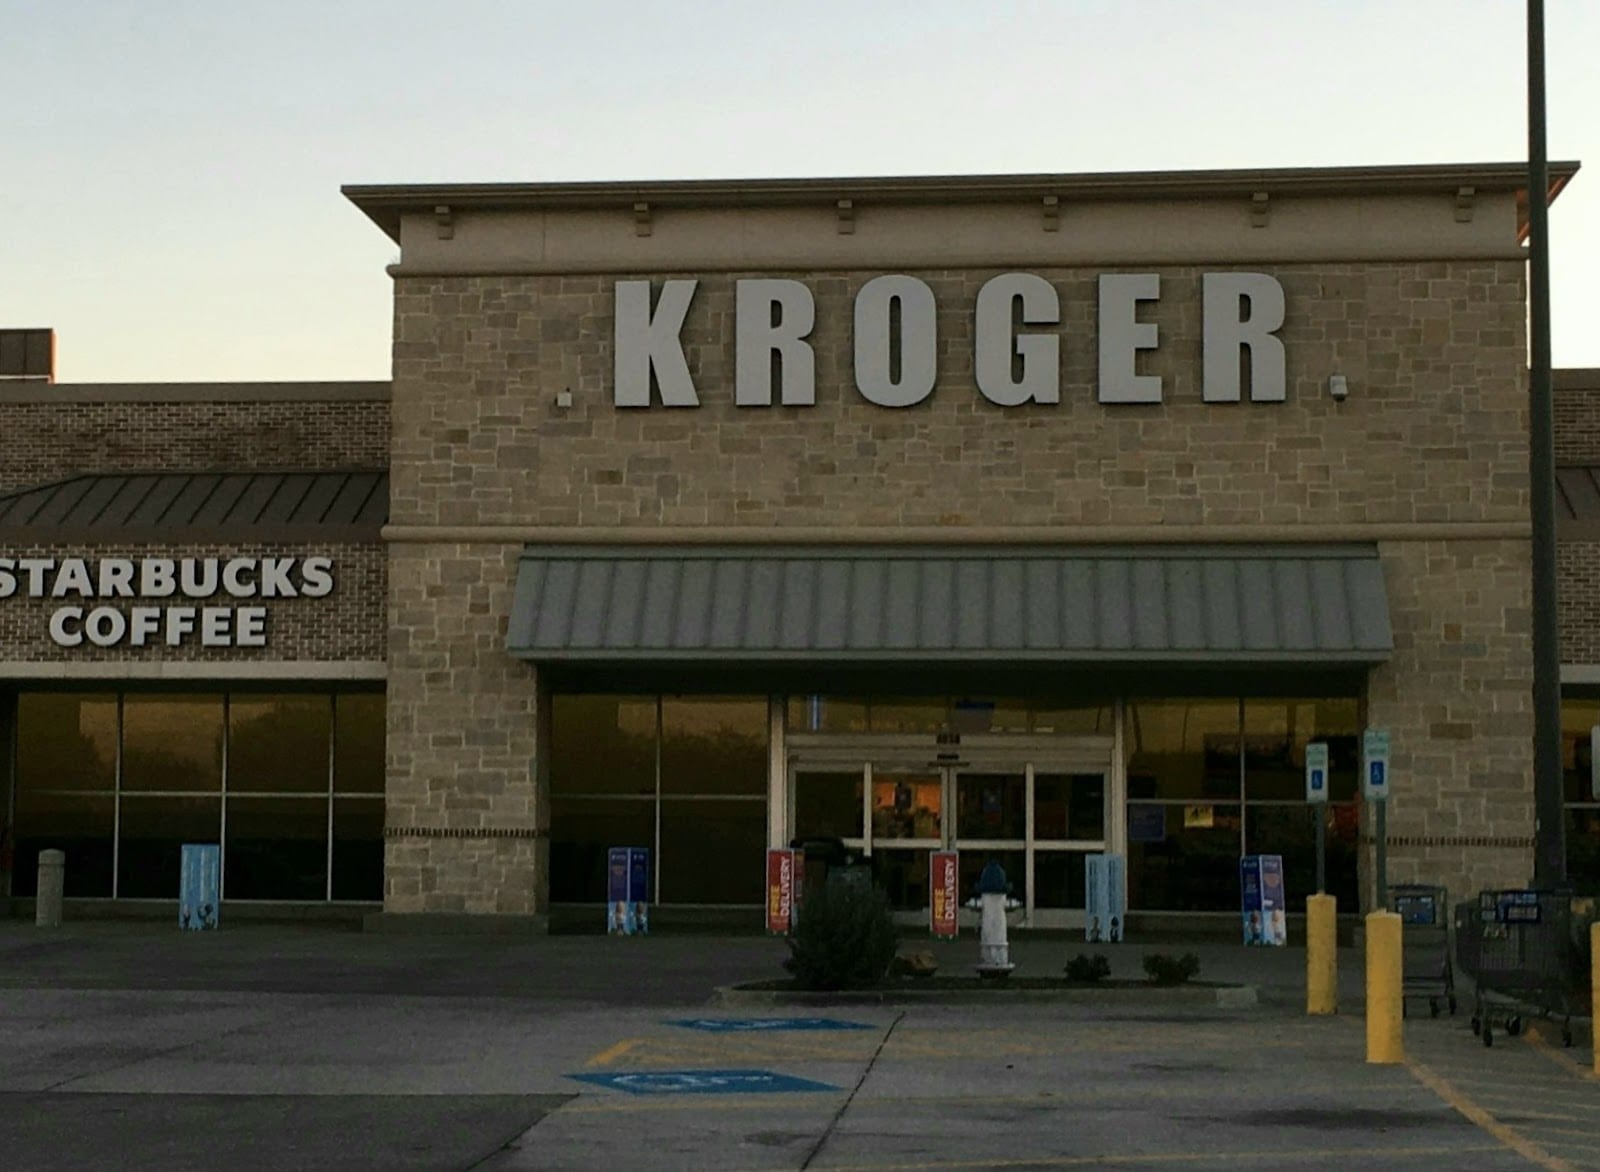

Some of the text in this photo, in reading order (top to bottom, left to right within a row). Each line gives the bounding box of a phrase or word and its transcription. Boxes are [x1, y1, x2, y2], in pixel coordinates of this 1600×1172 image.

[614, 273, 1286, 407] KROGER
[50, 606, 267, 646] COFFEE
[780, 856, 790, 916] DELIVERY
[934, 888, 944, 919] FREE
[945, 859, 955, 920] DELIVERY
